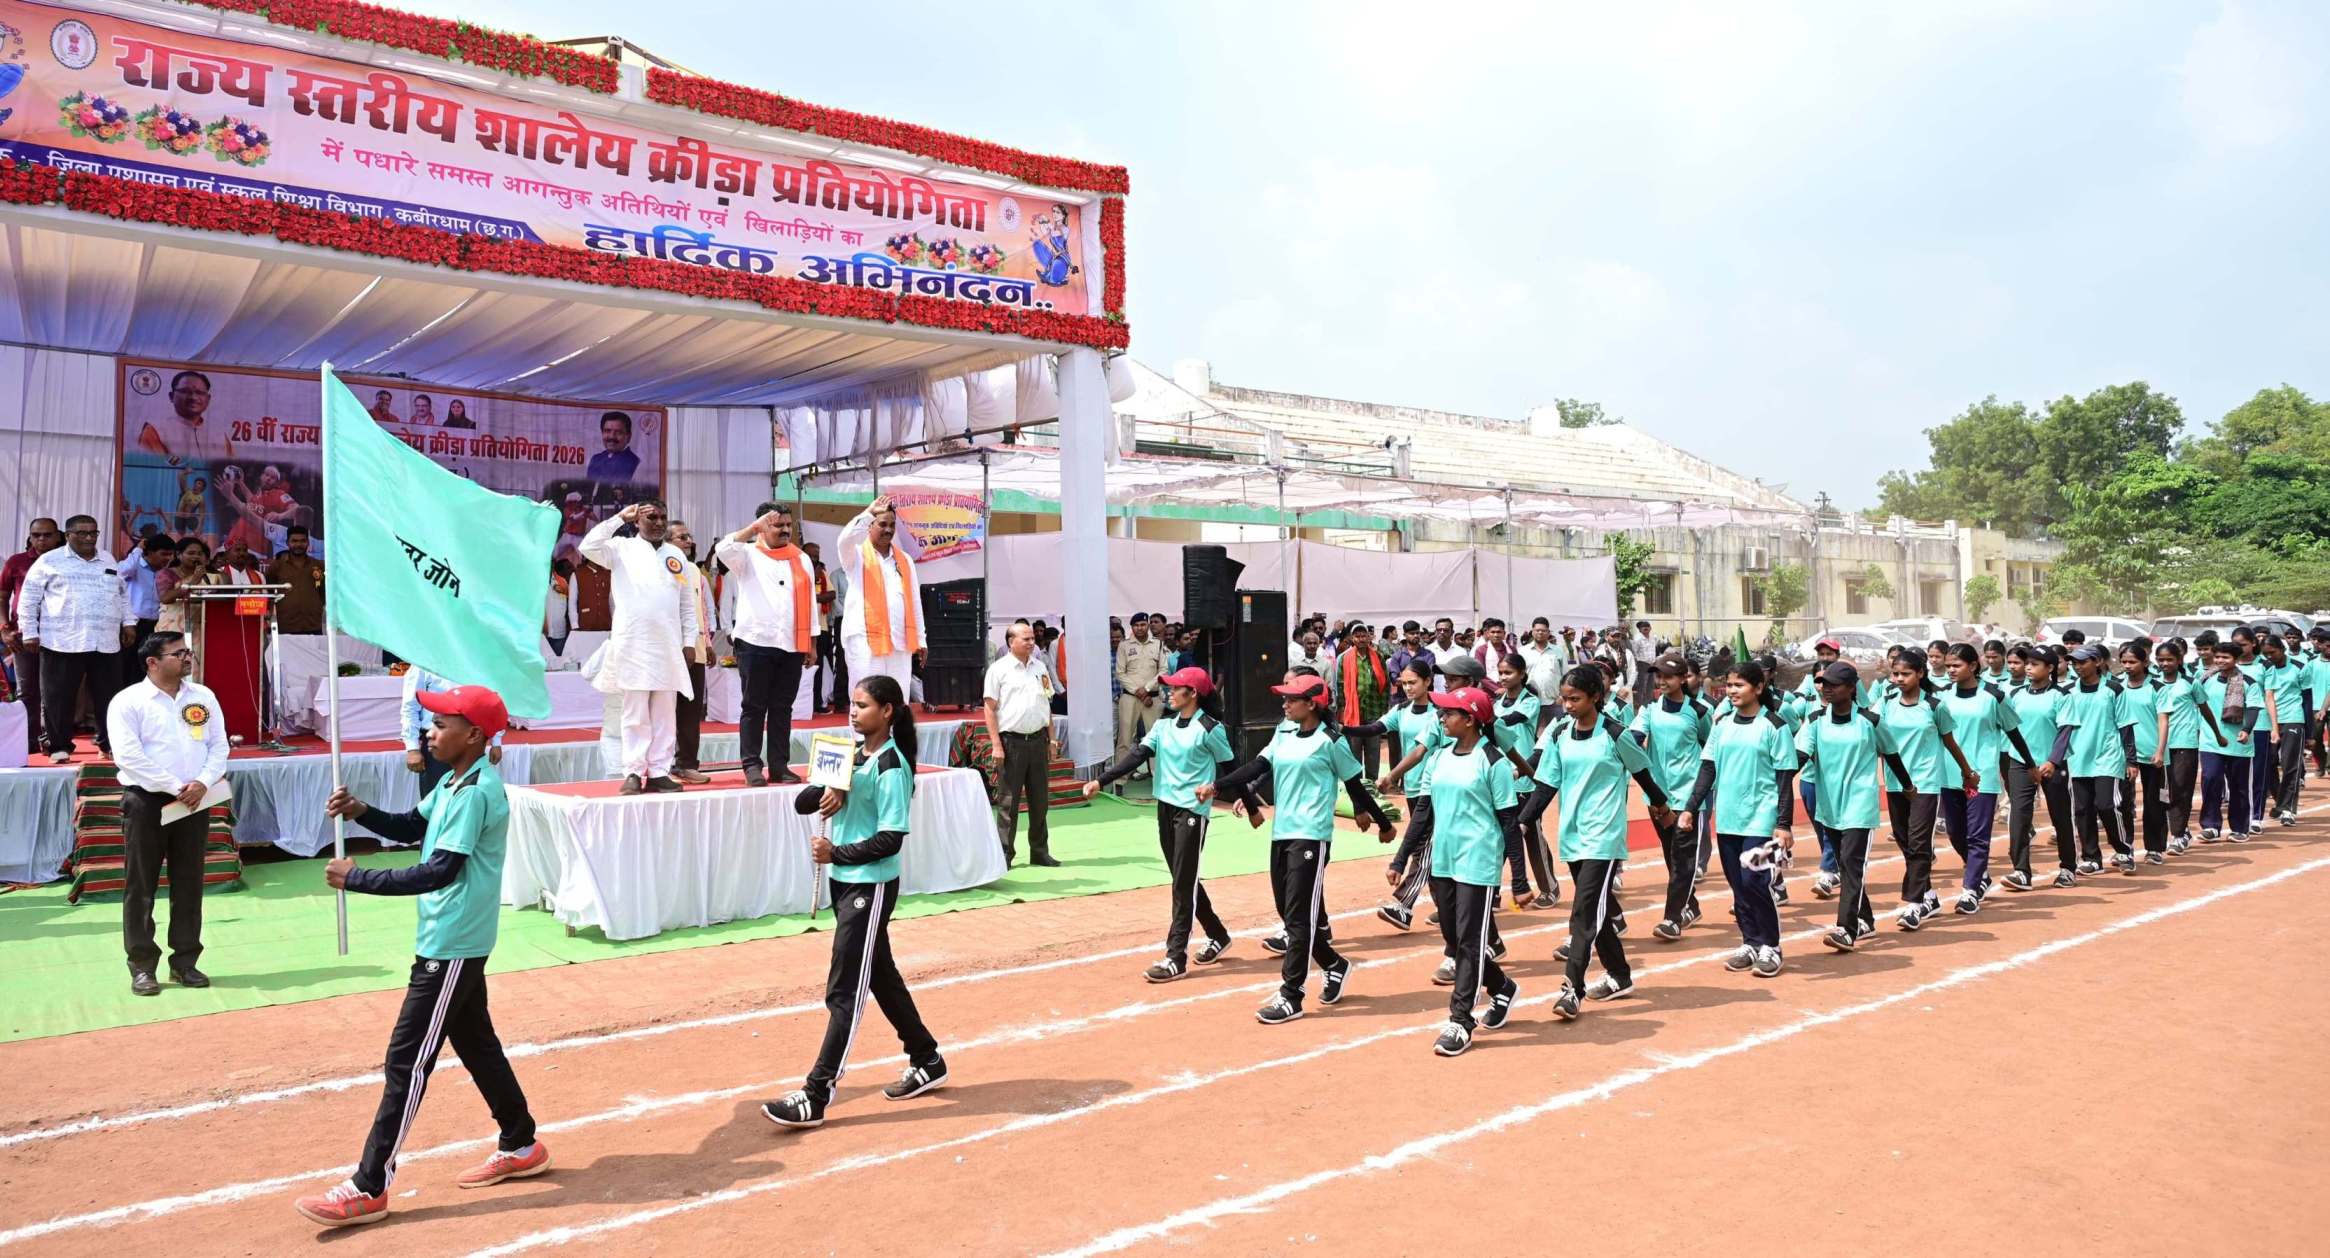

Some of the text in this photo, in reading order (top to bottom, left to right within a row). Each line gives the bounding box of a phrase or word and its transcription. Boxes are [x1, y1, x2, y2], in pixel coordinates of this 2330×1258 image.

[112, 36, 274, 108] राज्य
[286, 68, 464, 144] स्तरीय
[474, 107, 638, 177] शालेय
[647, 135, 763, 206] क्रीड़ा
[771, 159, 988, 233] प्रतियोगिता
[320, 137, 864, 247] में पधारे समस्त आगन्तुक अतिथियों एवं खिलाड़ियों का
[583, 224, 778, 274] हार्दिक
[231, 420, 252, 442] 26
[280, 423, 320, 445] राज्य
[470, 434, 549, 462] प्रतियोगिता
[551, 444, 585, 465] 2026
